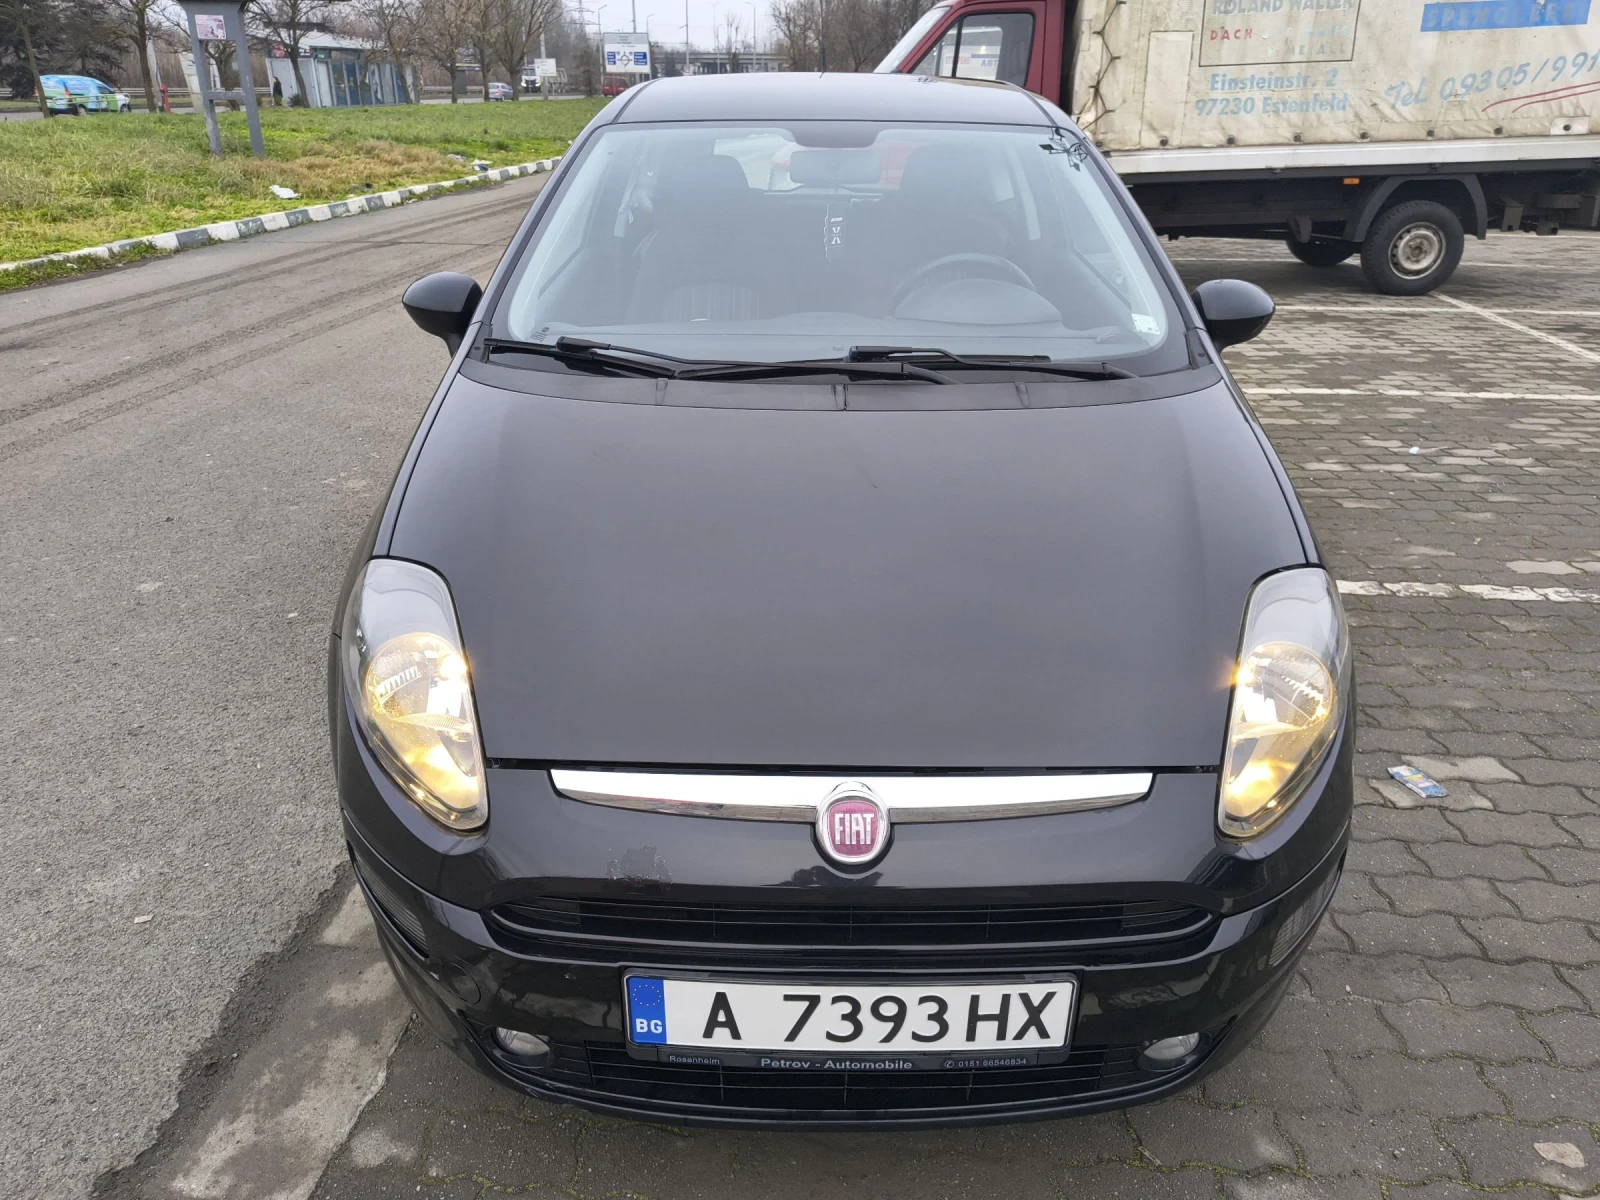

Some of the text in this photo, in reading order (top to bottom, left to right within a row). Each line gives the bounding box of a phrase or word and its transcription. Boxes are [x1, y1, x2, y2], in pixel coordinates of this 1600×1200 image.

[1210, 28, 1253, 41] DACH
[1210, 68, 1338, 91] Einsteinstr. 2
[1194, 93, 1350, 116] 97230 Estenfeld
[834, 812, 875, 845] FIAT
[635, 1018, 663, 1034] BG
[702, 991, 742, 1040] A
[782, 993, 950, 1043] 7393
[760, 1058, 811, 1068] Petrov
[824, 1060, 913, 1069] Automobile
[958, 1060, 980, 1068] 0151
